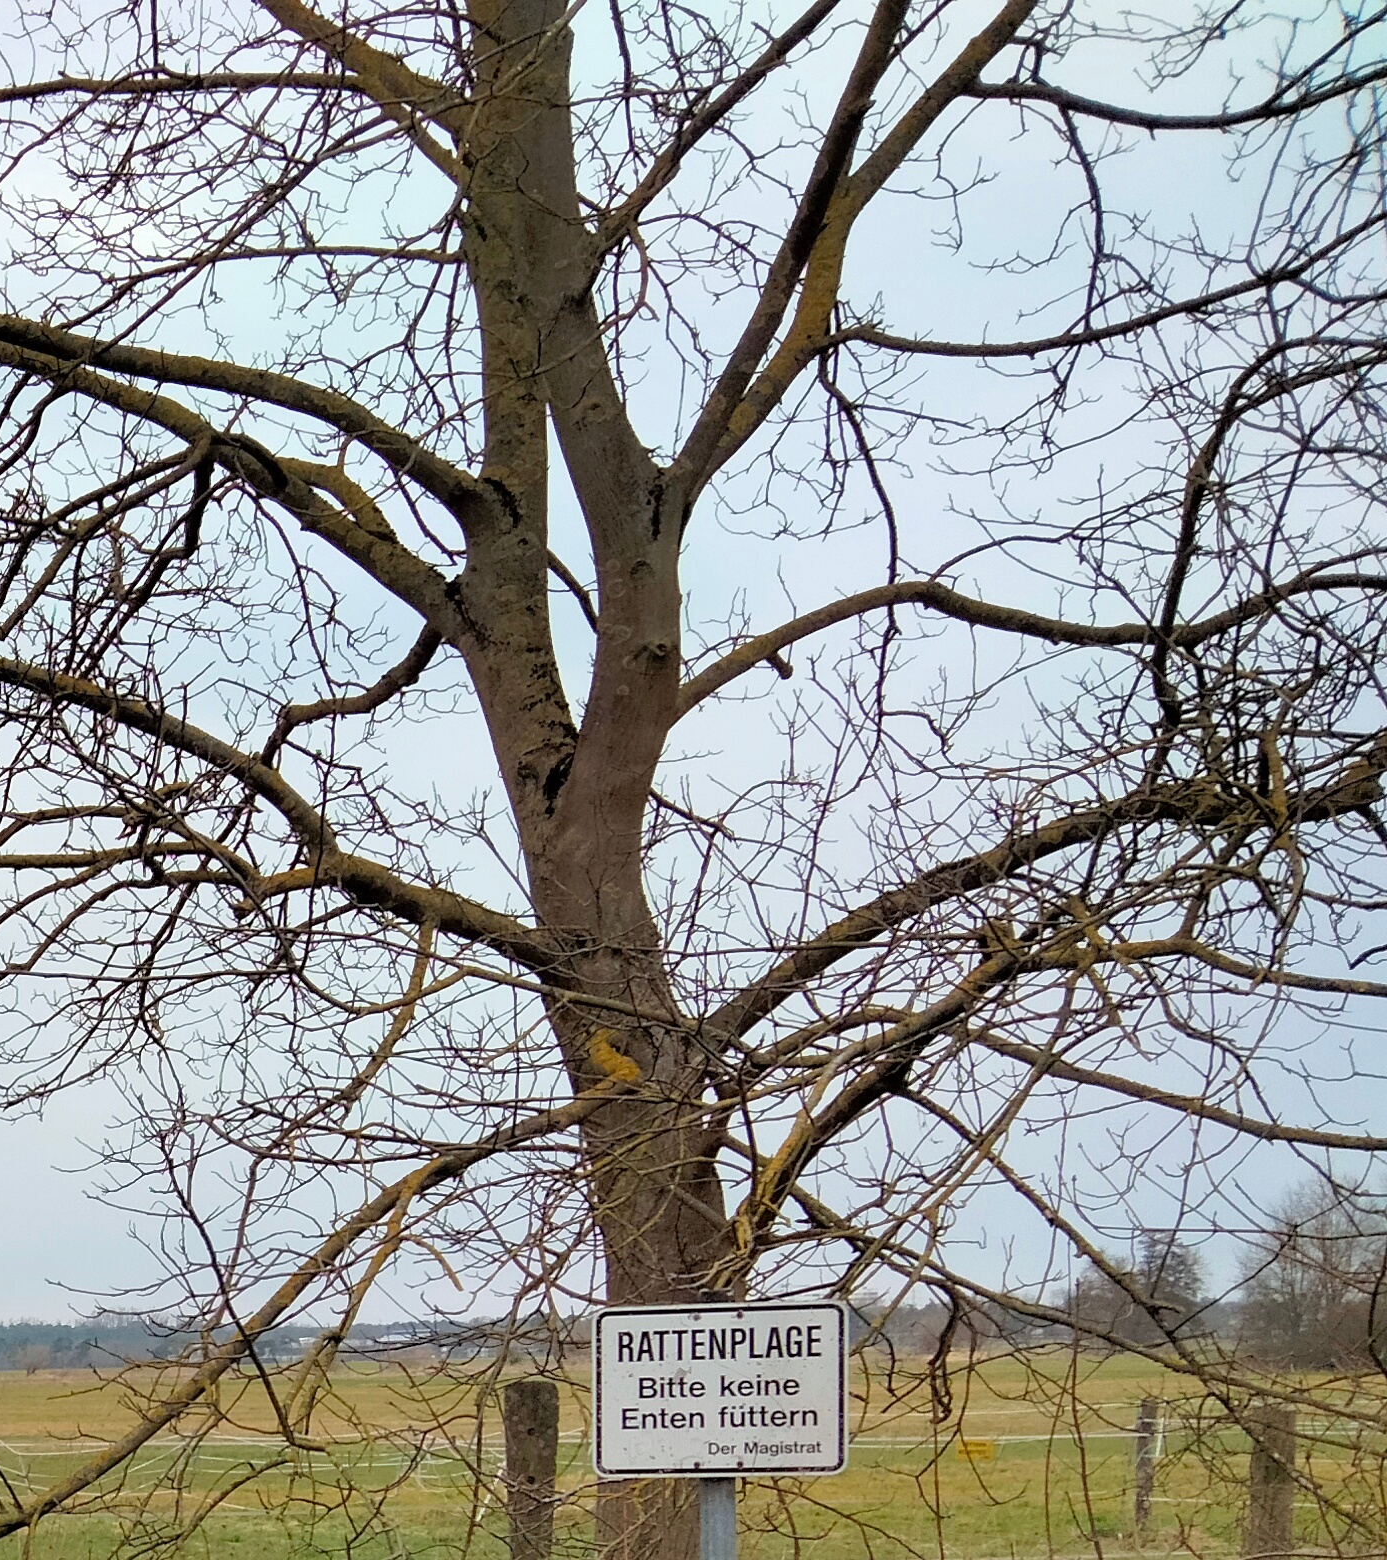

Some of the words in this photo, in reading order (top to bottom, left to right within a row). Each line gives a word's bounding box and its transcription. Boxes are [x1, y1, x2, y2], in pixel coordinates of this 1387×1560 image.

[617, 1325, 822, 1362] RATTENPLAGE
[638, 1376, 706, 1399] Bitte
[720, 1374, 800, 1397] keine
[621, 1407, 704, 1430] Enten
[718, 1405, 818, 1428] füttern
[708, 1442, 736, 1455] Der
[744, 1440, 822, 1456] Magistrat
